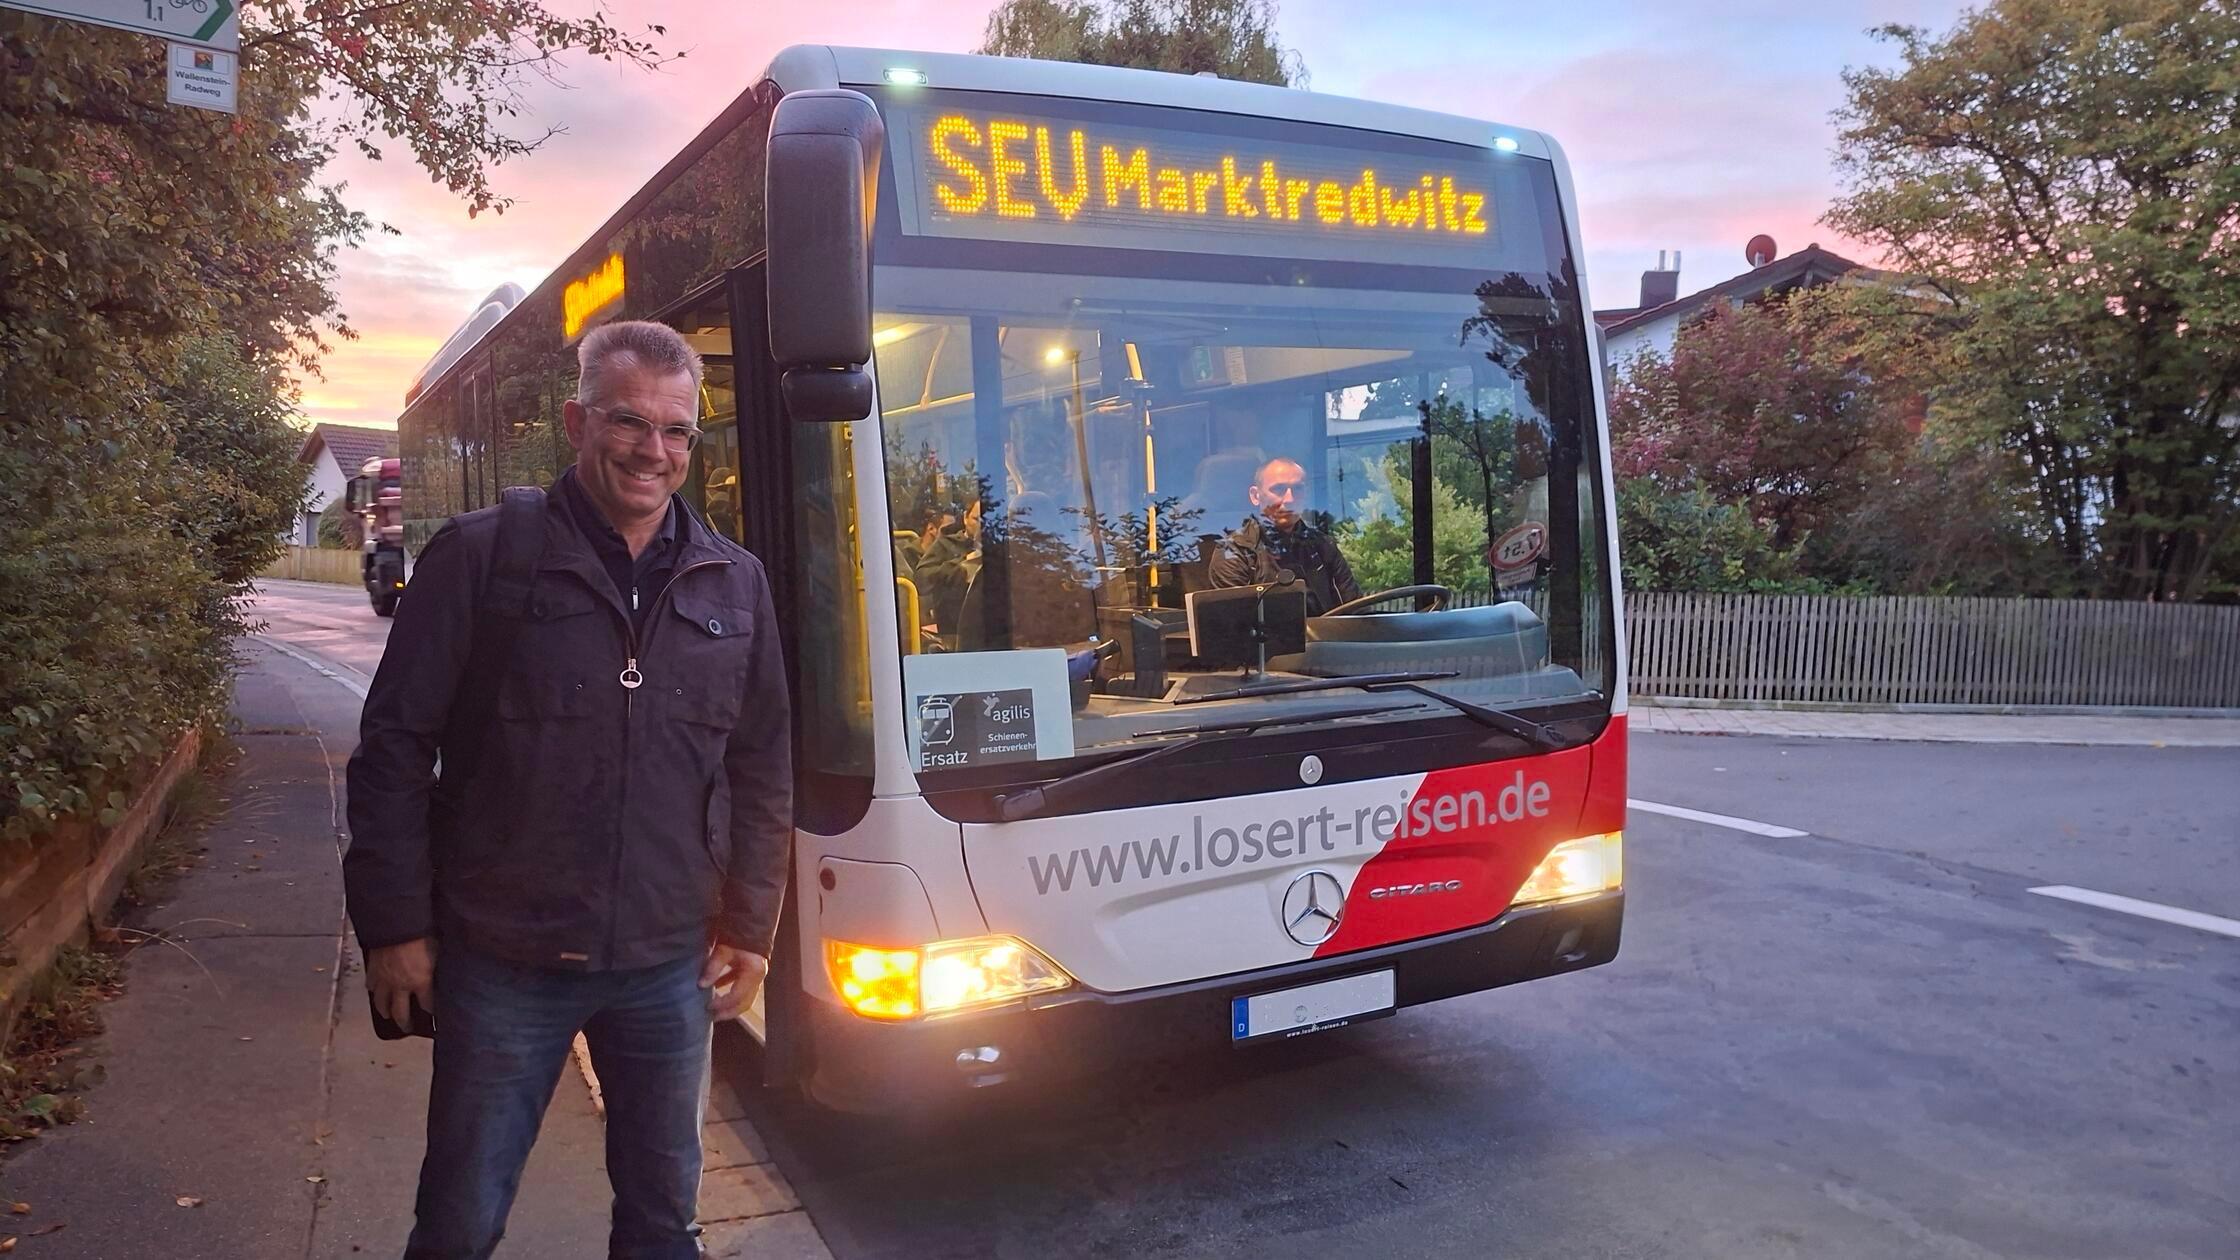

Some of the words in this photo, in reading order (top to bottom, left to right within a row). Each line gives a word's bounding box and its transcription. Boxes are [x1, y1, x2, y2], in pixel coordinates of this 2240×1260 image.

[175, 70, 231, 86] Wallenstein-
[184, 83, 221, 97] Radweg
[932, 115, 1090, 221] SEV
[1102, 145, 1488, 234] Marktredwitz
[992, 705, 1031, 723] agilis
[987, 732, 1028, 743] Schienen-
[979, 742, 1037, 754] ersatzverkehr
[921, 750, 968, 767] Ersatz
[1028, 770, 1551, 895] www.losert-reisen.de
[1370, 880, 1461, 898] CITARO
[1238, 1022, 1245, 1033] D
